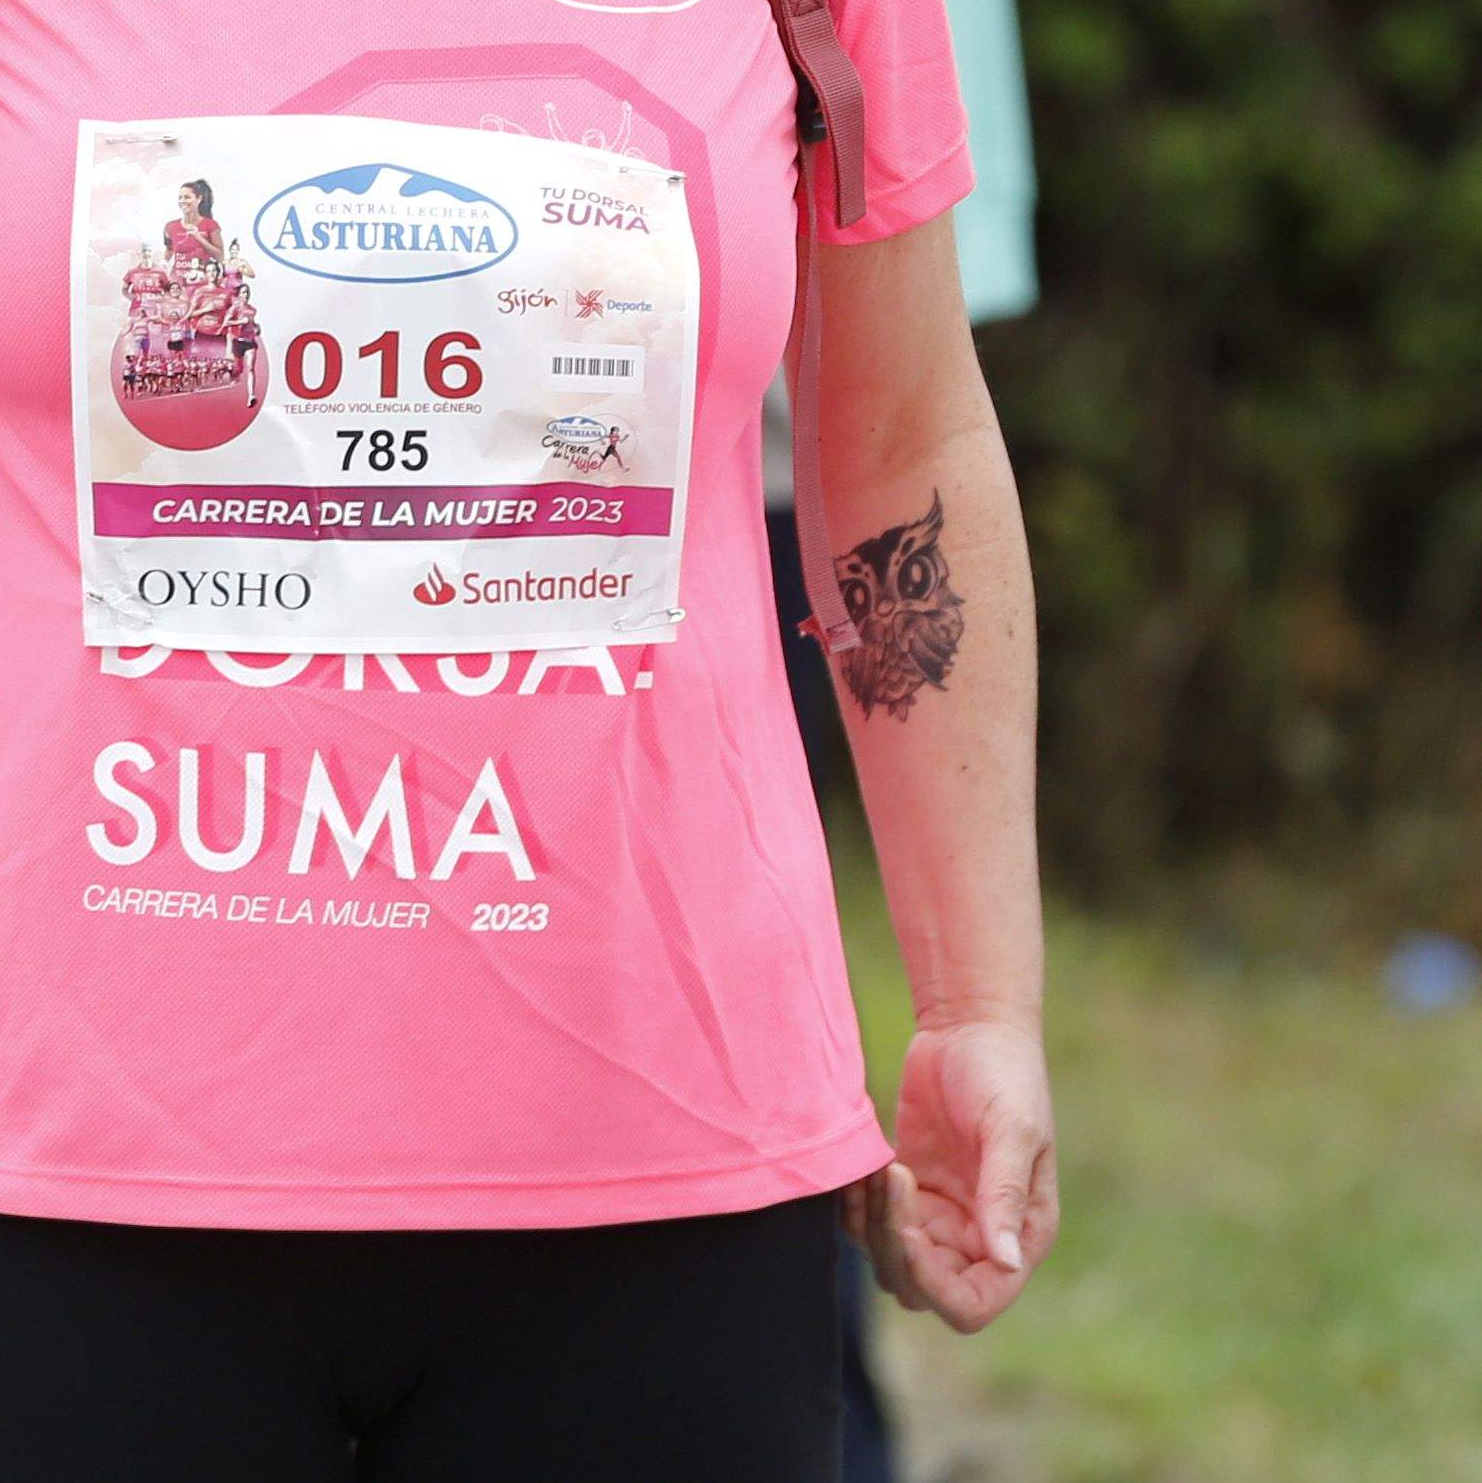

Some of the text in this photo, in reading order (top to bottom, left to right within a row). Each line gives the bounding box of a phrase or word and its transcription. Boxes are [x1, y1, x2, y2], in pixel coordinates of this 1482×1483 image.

[315, 203, 490, 219] CENTRAL LECHERA
[540, 187, 650, 217] TU DORSAL
[542, 202, 650, 234] SUMA
[273, 205, 498, 253] ASTURIANA
[497, 288, 558, 316] gijón
[607, 299, 652, 313] Deporte
[284, 330, 483, 400] 016
[284, 401, 482, 414] TELÉFONO VIOLENCIA DE GÉNERO
[336, 429, 428, 472] 785
[152, 496, 624, 527] CARRERA DE LA MUJER 2023
[138, 569, 311, 610] OYSHO
[463, 568, 633, 605] Santander
[85, 741, 536, 880] SUMA
[83, 884, 550, 931] CARRERA DE LA MUJER 2023
